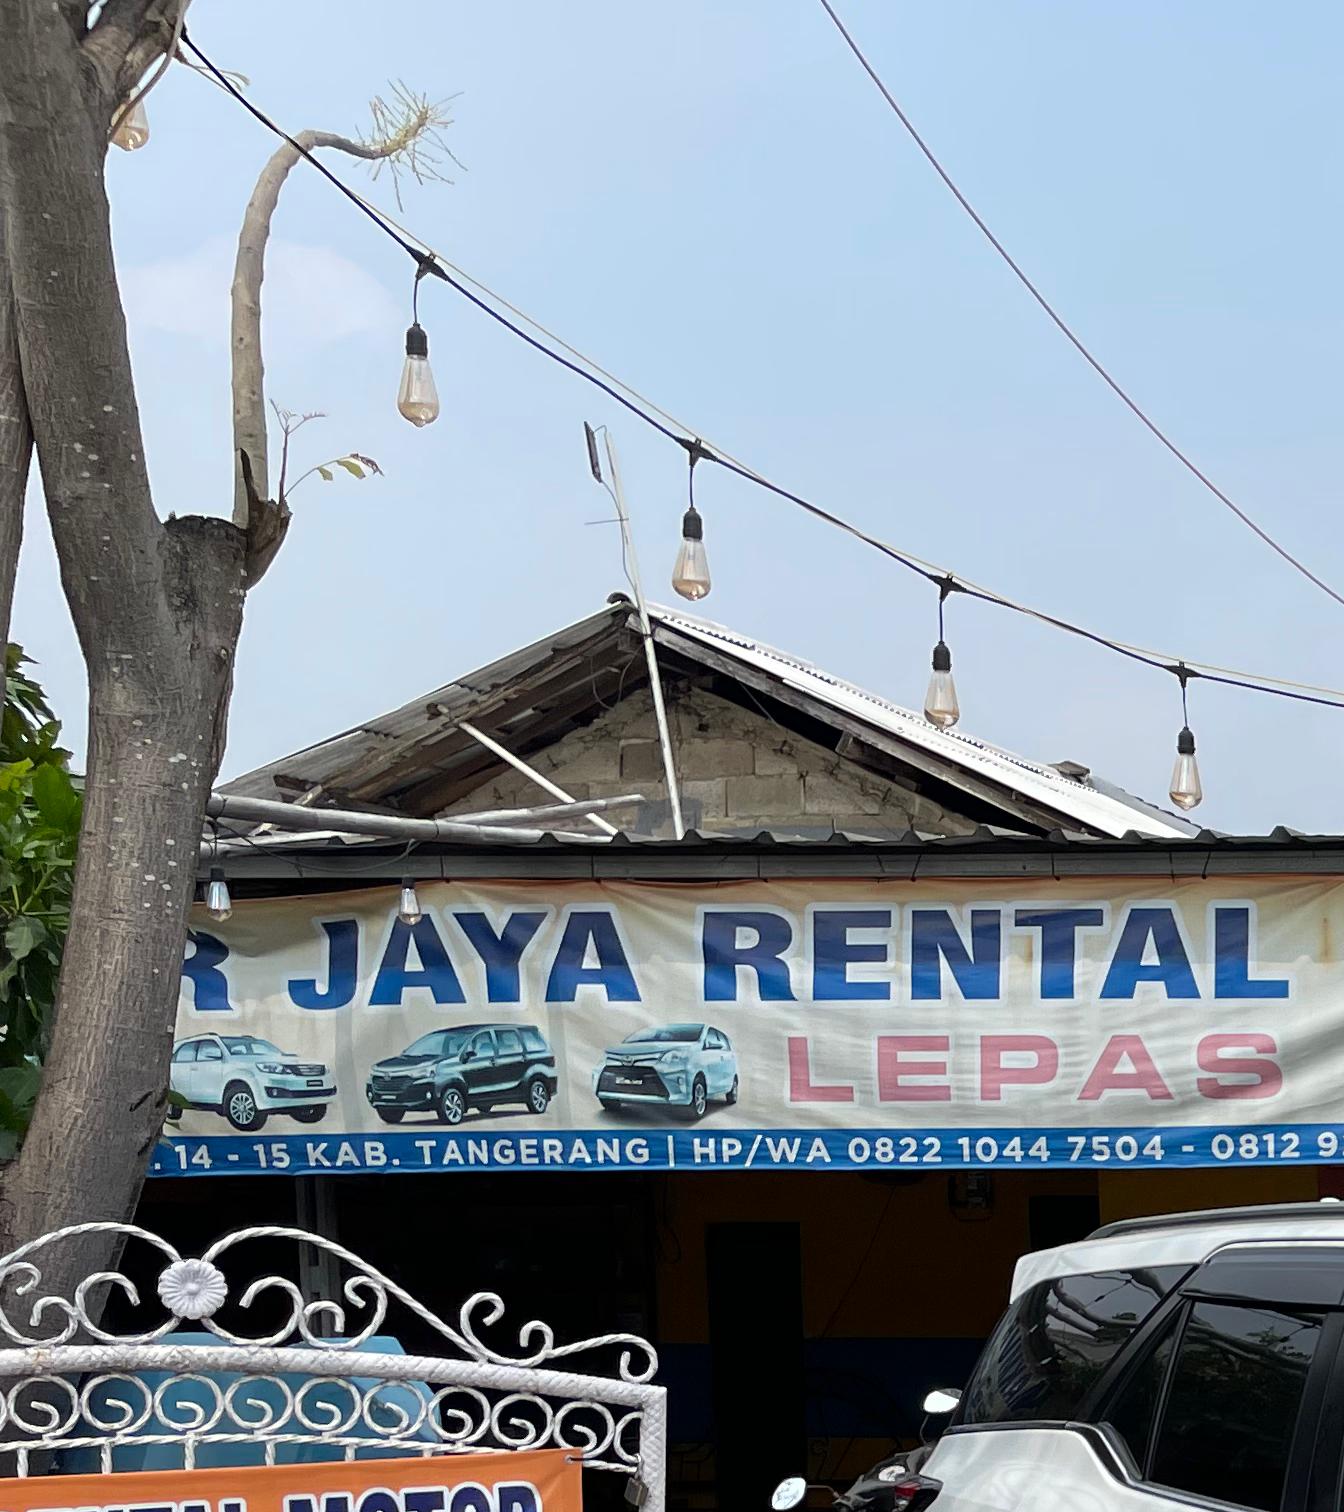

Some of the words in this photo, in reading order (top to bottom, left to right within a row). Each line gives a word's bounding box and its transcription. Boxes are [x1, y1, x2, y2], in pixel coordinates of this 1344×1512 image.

[288, 912, 642, 1011] JAYA
[702, 908, 1290, 1001] RENTAL
[789, 1034, 1281, 1101] LEPAS
[175, 1145, 212, 1169] 14
[254, 1143, 290, 1168] 15
[307, 1142, 400, 1167] KAB.
[415, 1138, 650, 1165] TANGERANG
[693, 1134, 832, 1167] HP/WA
[848, 1136, 942, 1163] 0822
[957, 1136, 1051, 1163] 1044
[1067, 1135, 1165, 1162] 7504
[1211, 1132, 1300, 1160] 0812
